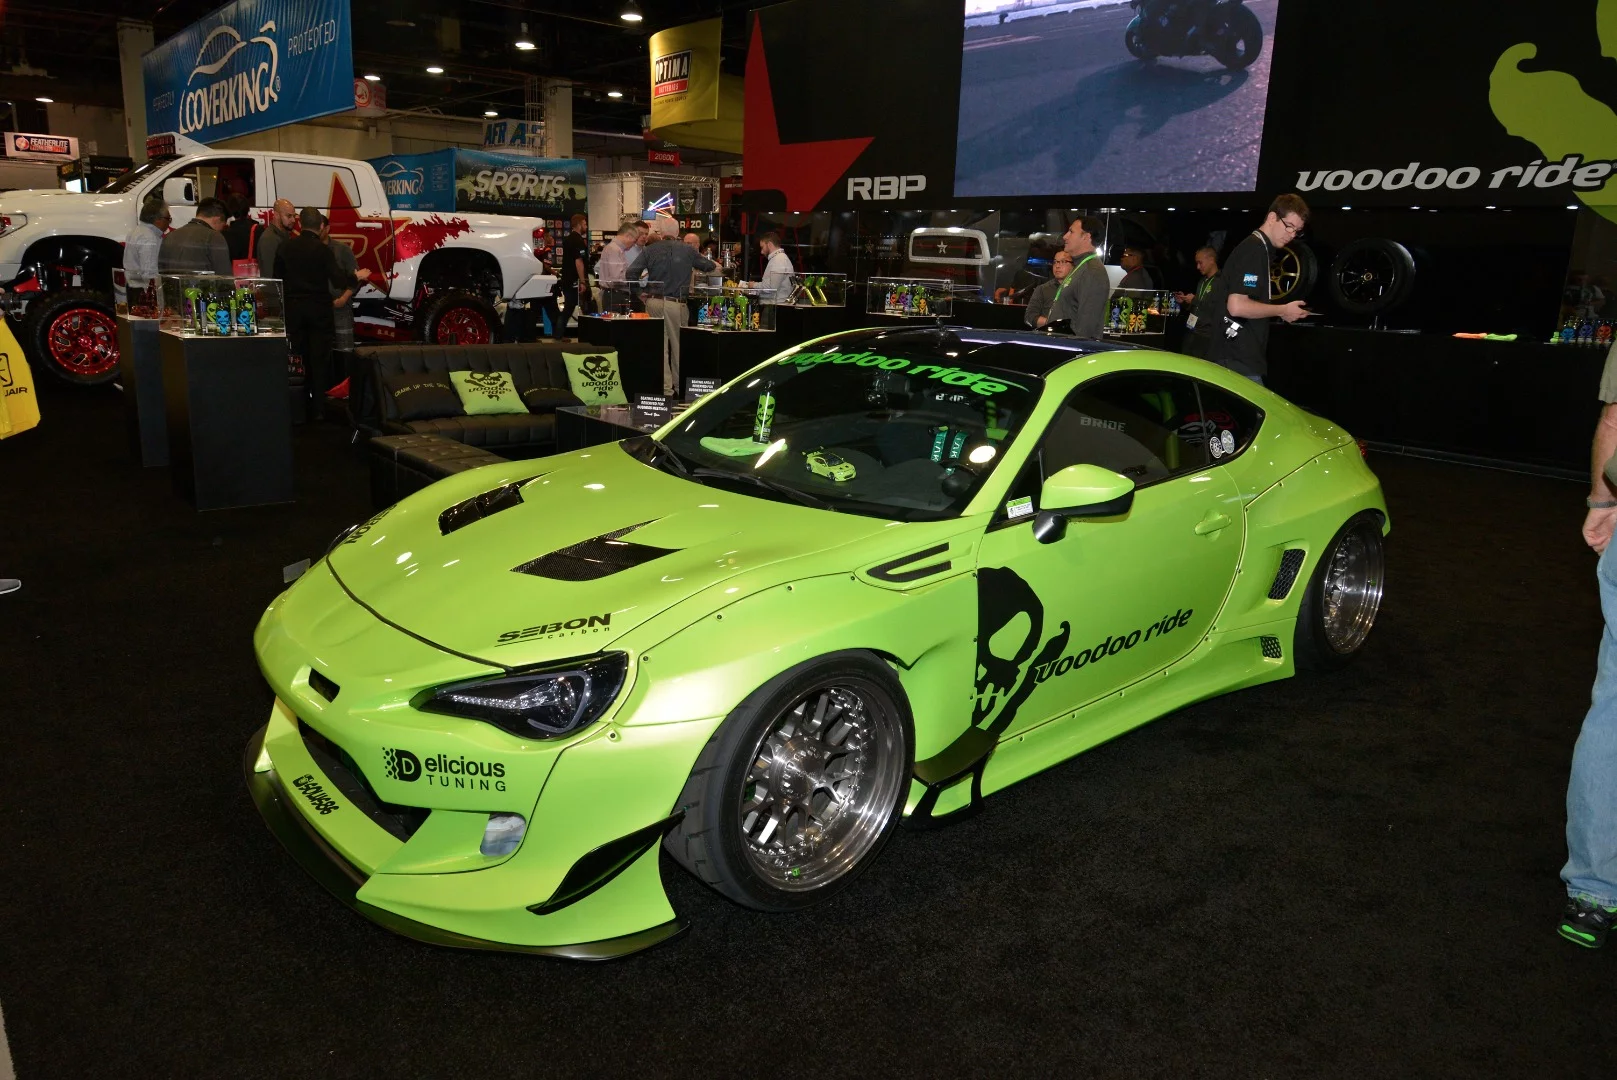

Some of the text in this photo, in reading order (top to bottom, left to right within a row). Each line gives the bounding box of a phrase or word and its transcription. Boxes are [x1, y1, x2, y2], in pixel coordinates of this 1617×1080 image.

[287, 19, 336, 58] PROTECTED
[655, 56, 688, 83] OPTIMA
[182, 62, 272, 133] COVERKING
[30, 137, 69, 147] FEATHERLITE
[473, 169, 566, 198] SPORTS
[847, 174, 927, 200] RBP
[1295, 157, 1613, 192] voodoo ride
[468, 385, 512, 393] voodoo
[481, 387, 506, 395] ride
[581, 380, 619, 388] voodoo
[907, 364, 1008, 396] ride
[1079, 416, 1127, 432] BRIDE
[496, 612, 611, 643] SEBON
[547, 626, 610, 640] carbon
[1034, 608, 1194, 684] voodoo ride
[425, 774, 507, 792] TUNING
